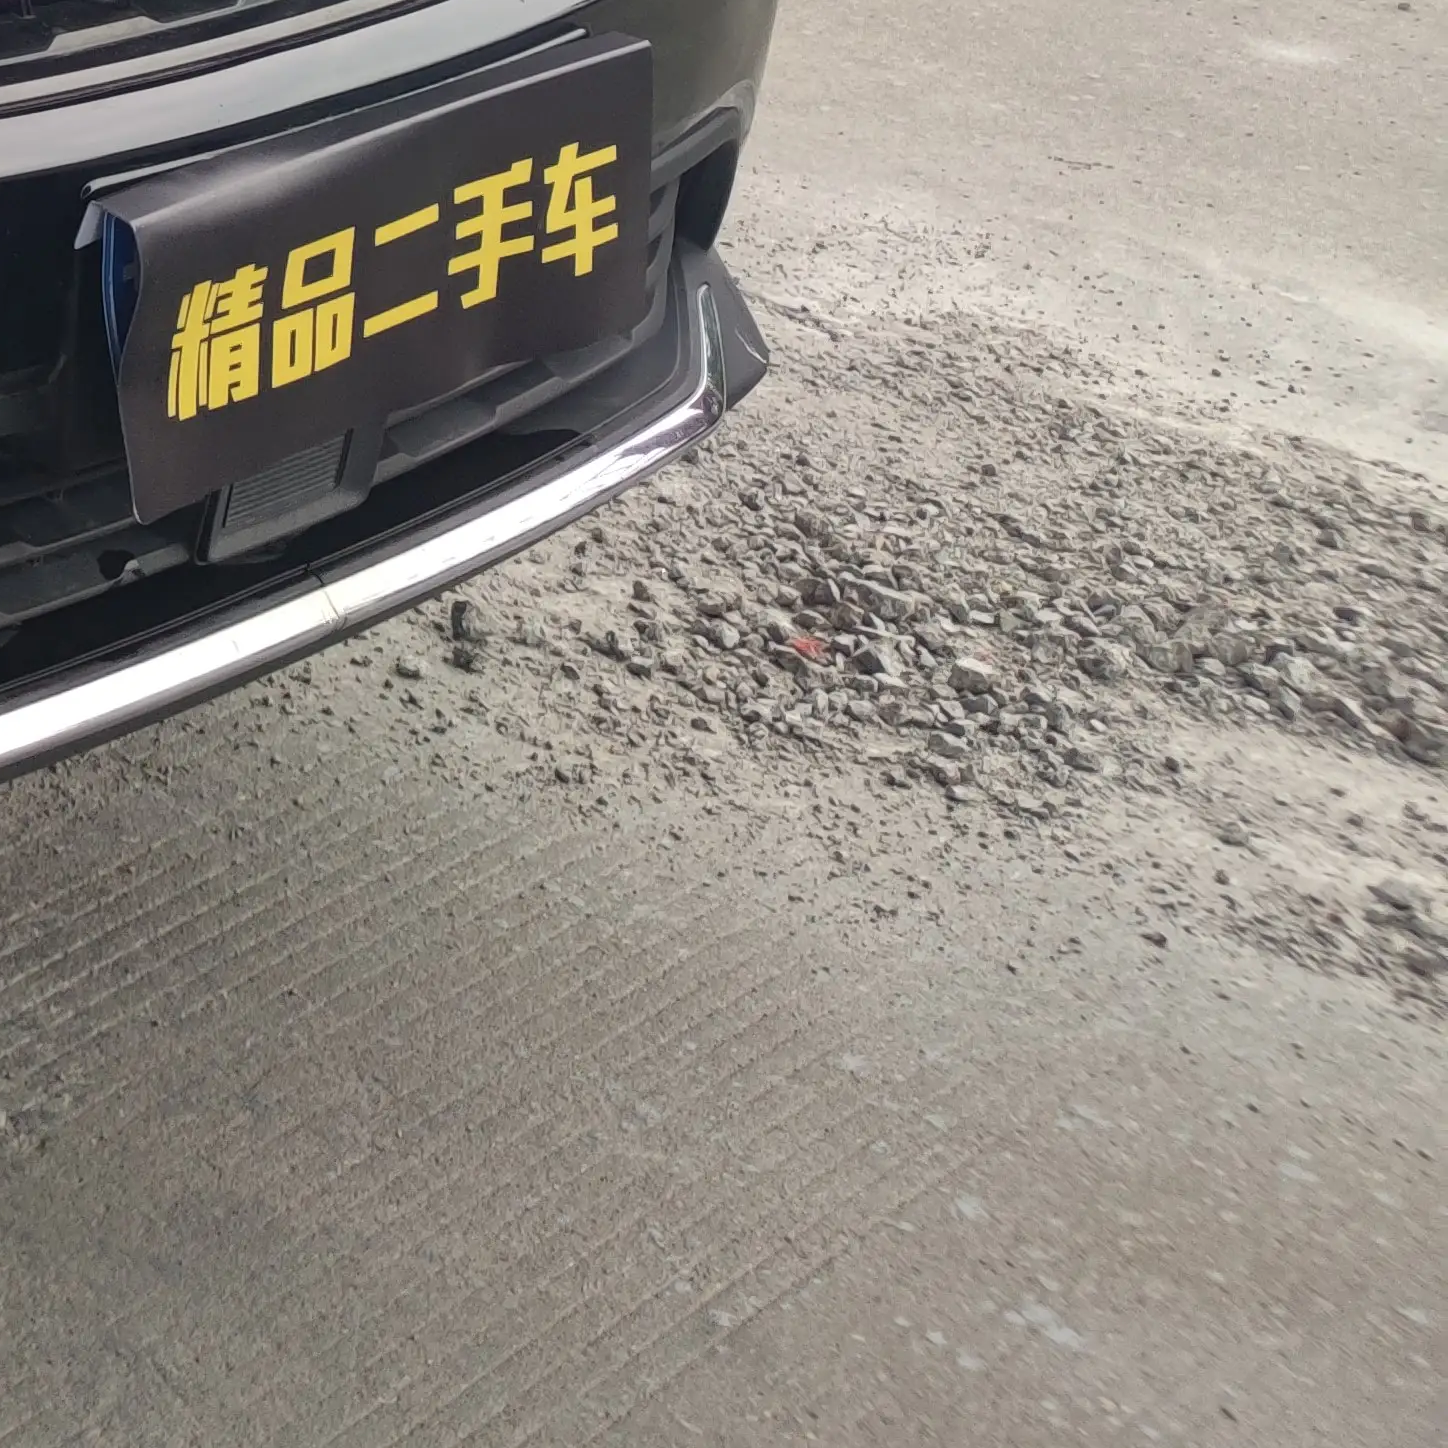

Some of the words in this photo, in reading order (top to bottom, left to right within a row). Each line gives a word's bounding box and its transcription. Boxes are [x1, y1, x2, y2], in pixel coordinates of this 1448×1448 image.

[168, 141, 619, 421] 精品二手车
